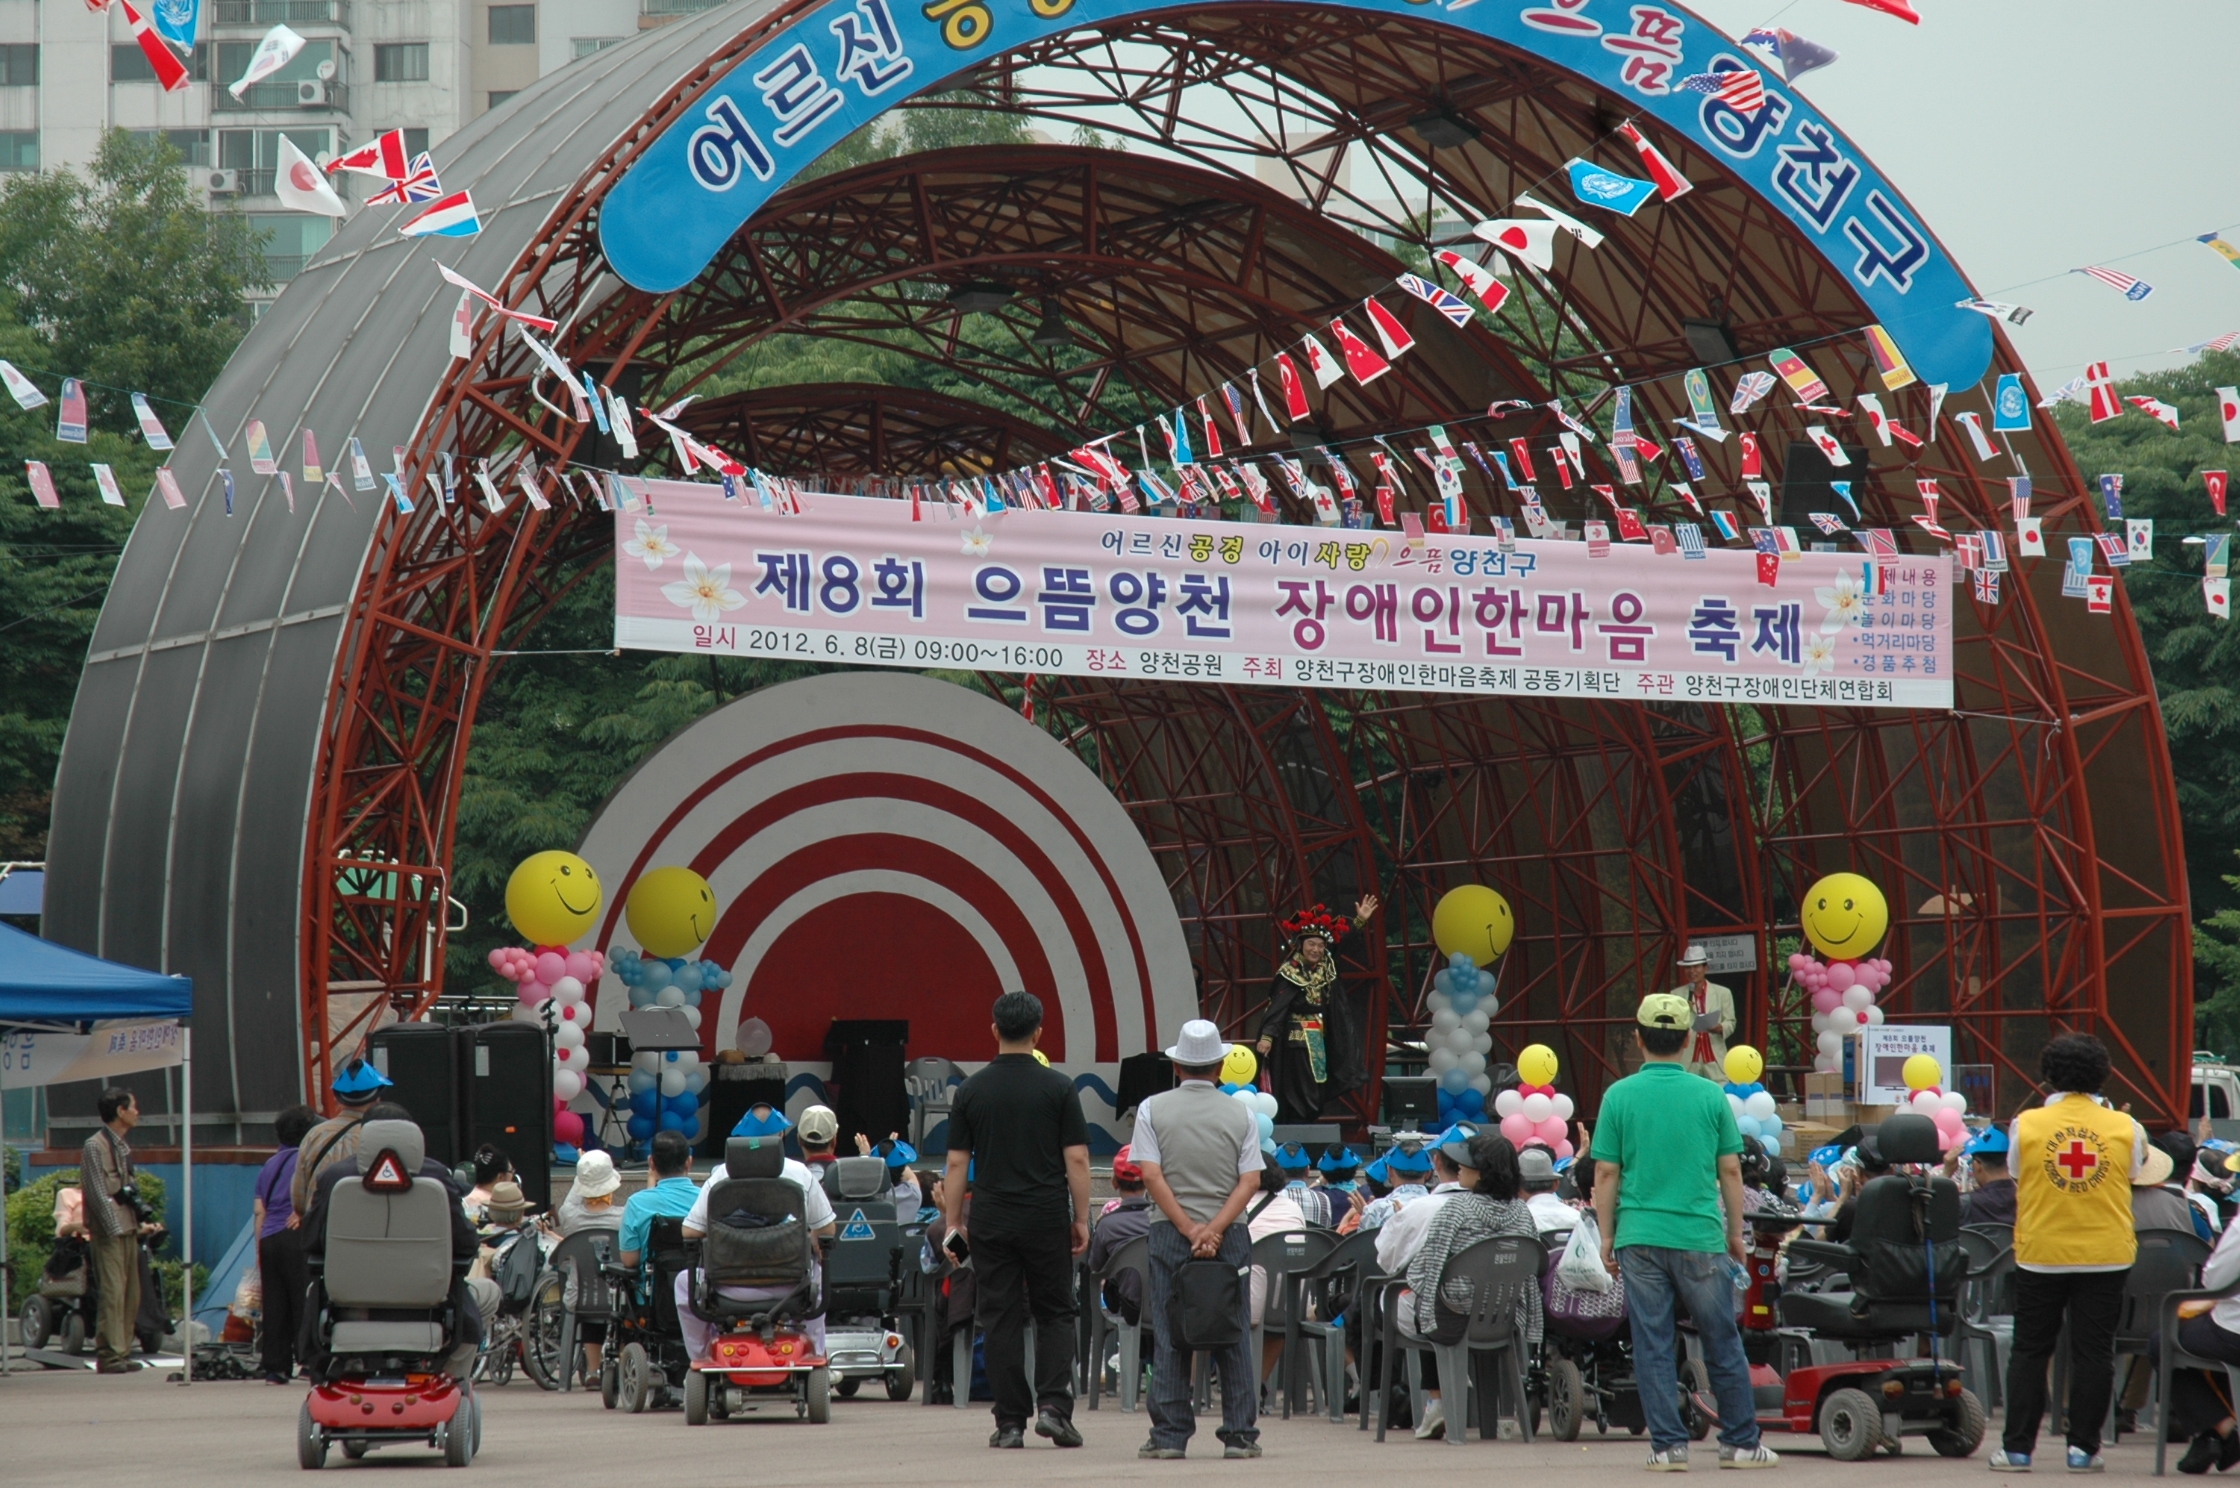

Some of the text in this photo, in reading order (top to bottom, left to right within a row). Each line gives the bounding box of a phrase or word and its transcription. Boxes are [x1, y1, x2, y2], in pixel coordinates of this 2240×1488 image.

[755, 552, 1801, 665] 제8회 으뜸양천 장애인한마음 축제
[693, 625, 737, 649] 일시
[914, 640, 1063, 668] 09:00~16:00
[1861, 634, 1937, 653] 먹거리마당
[1085, 649, 1894, 703] 장소 양천공원 주최 양천구장애인한마음축제 공동기획단 주관 양천구장애인단체연합회
